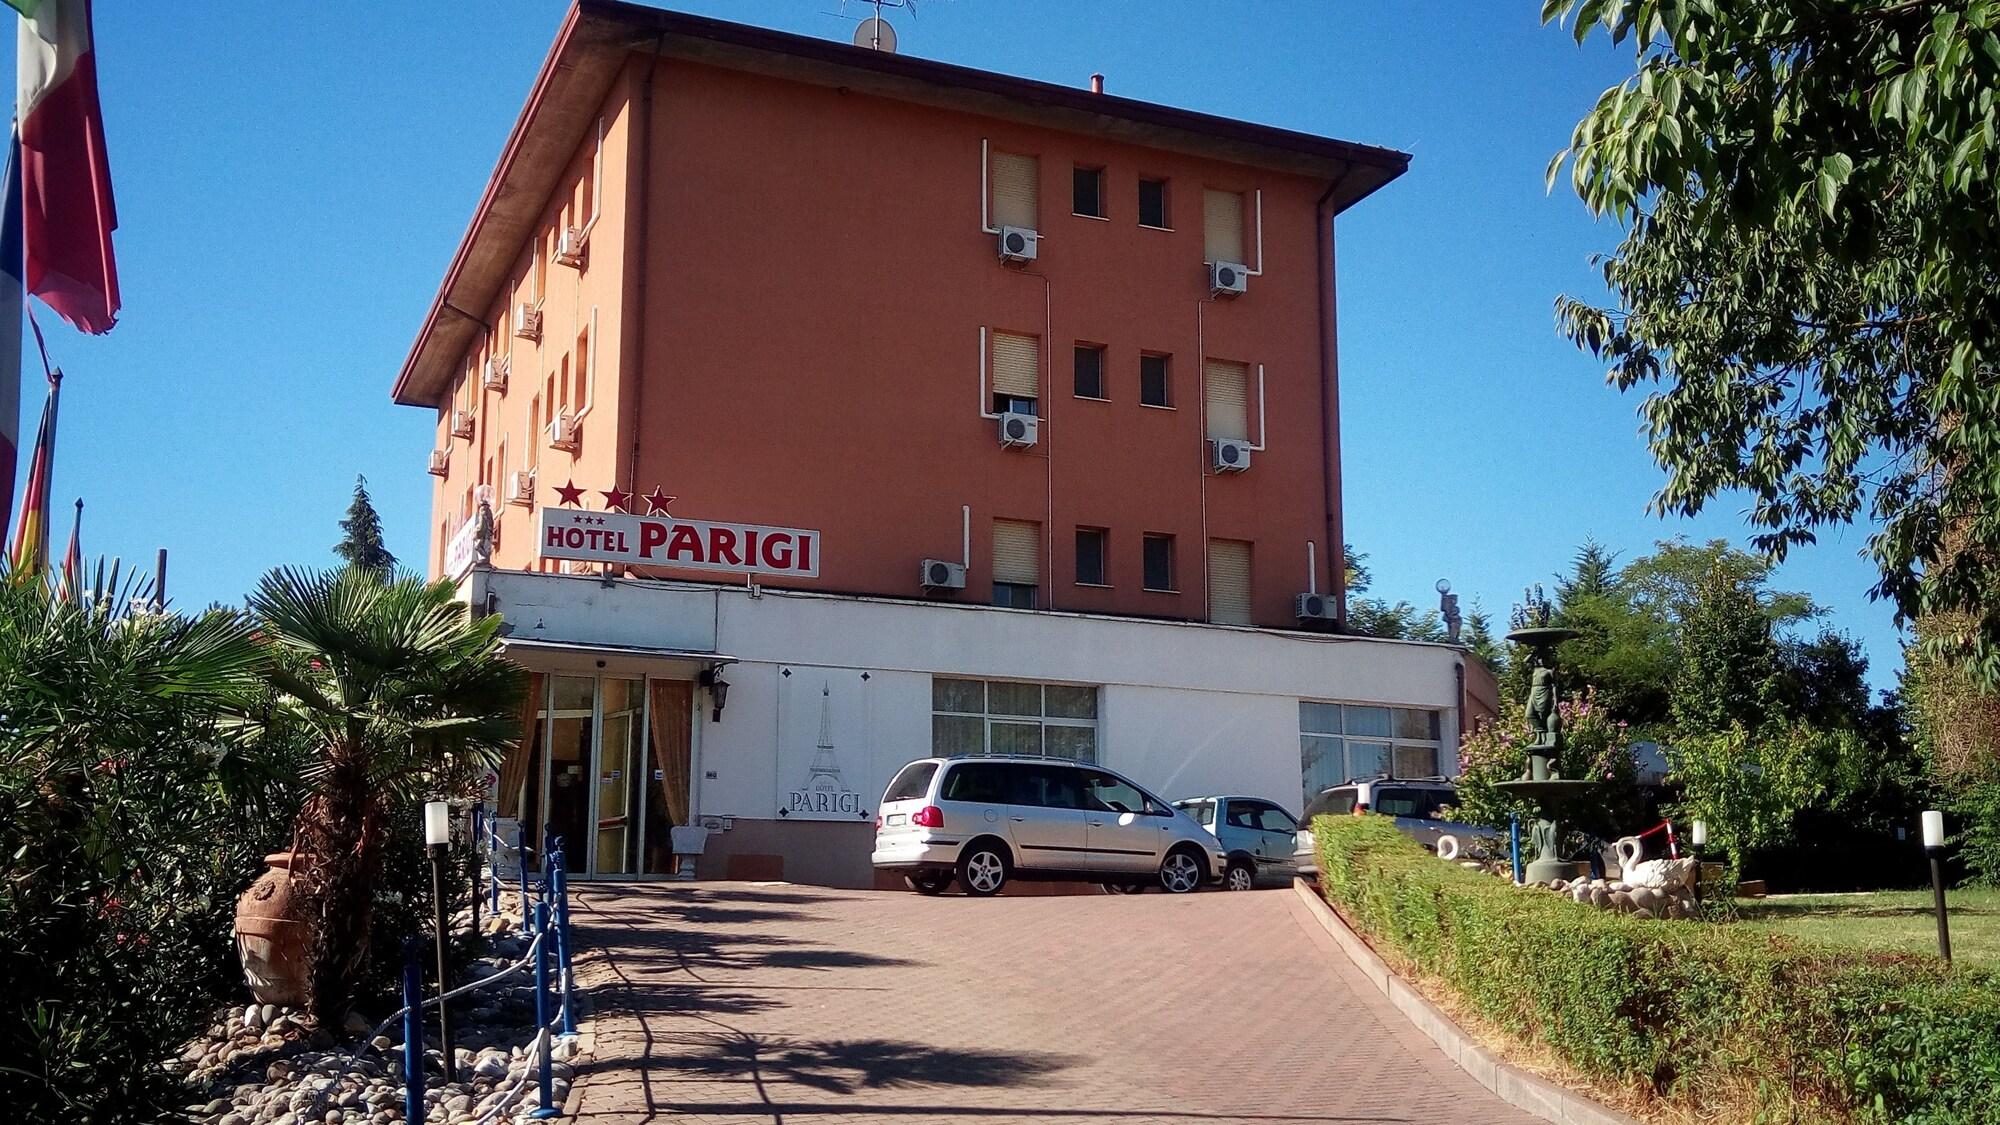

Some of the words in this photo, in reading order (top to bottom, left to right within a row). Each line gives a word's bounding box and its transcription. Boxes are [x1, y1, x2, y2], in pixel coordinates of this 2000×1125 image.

[546, 526, 629, 552] HOTEL
[639, 521, 812, 571] PARIGI
[789, 792, 860, 813] PARIGI
